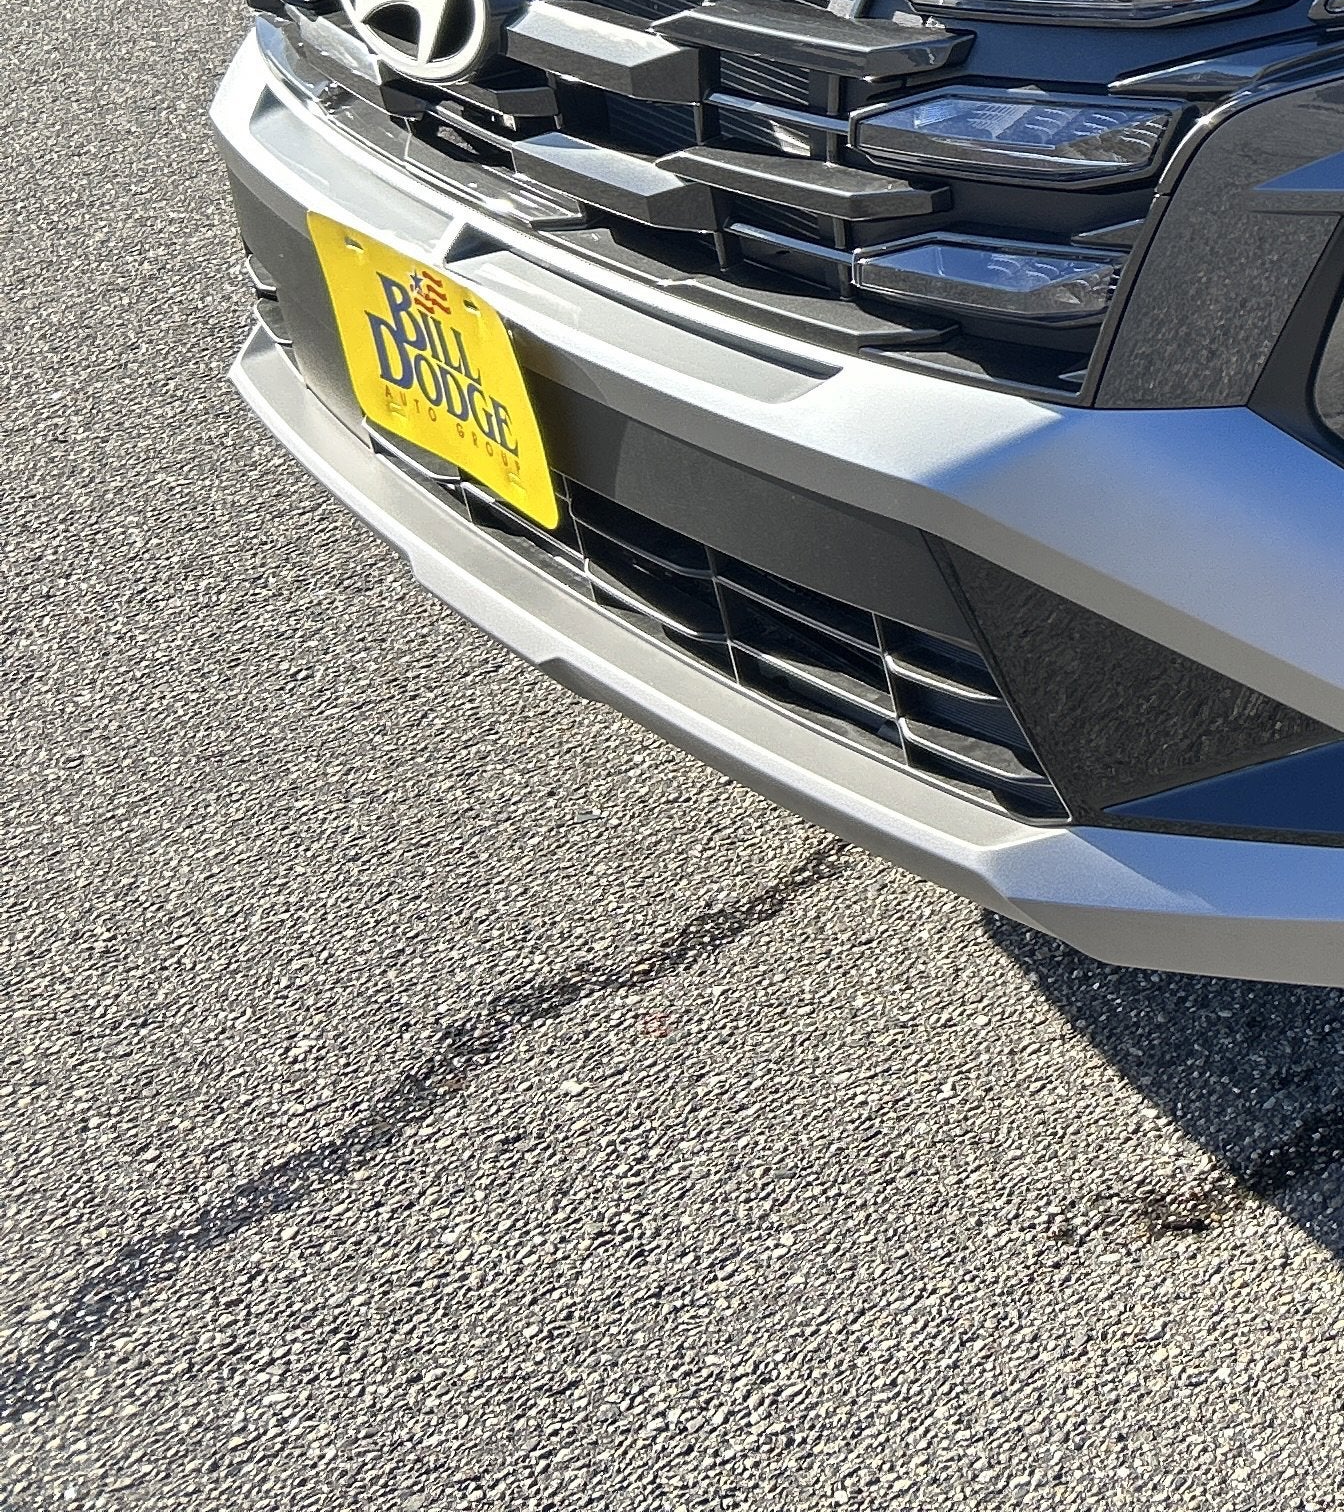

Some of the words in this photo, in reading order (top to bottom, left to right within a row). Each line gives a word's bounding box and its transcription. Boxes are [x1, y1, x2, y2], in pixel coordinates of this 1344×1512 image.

[365, 310, 519, 455] DODGE
[376, 271, 482, 386] BILL
[385, 385, 437, 422] AUTO
